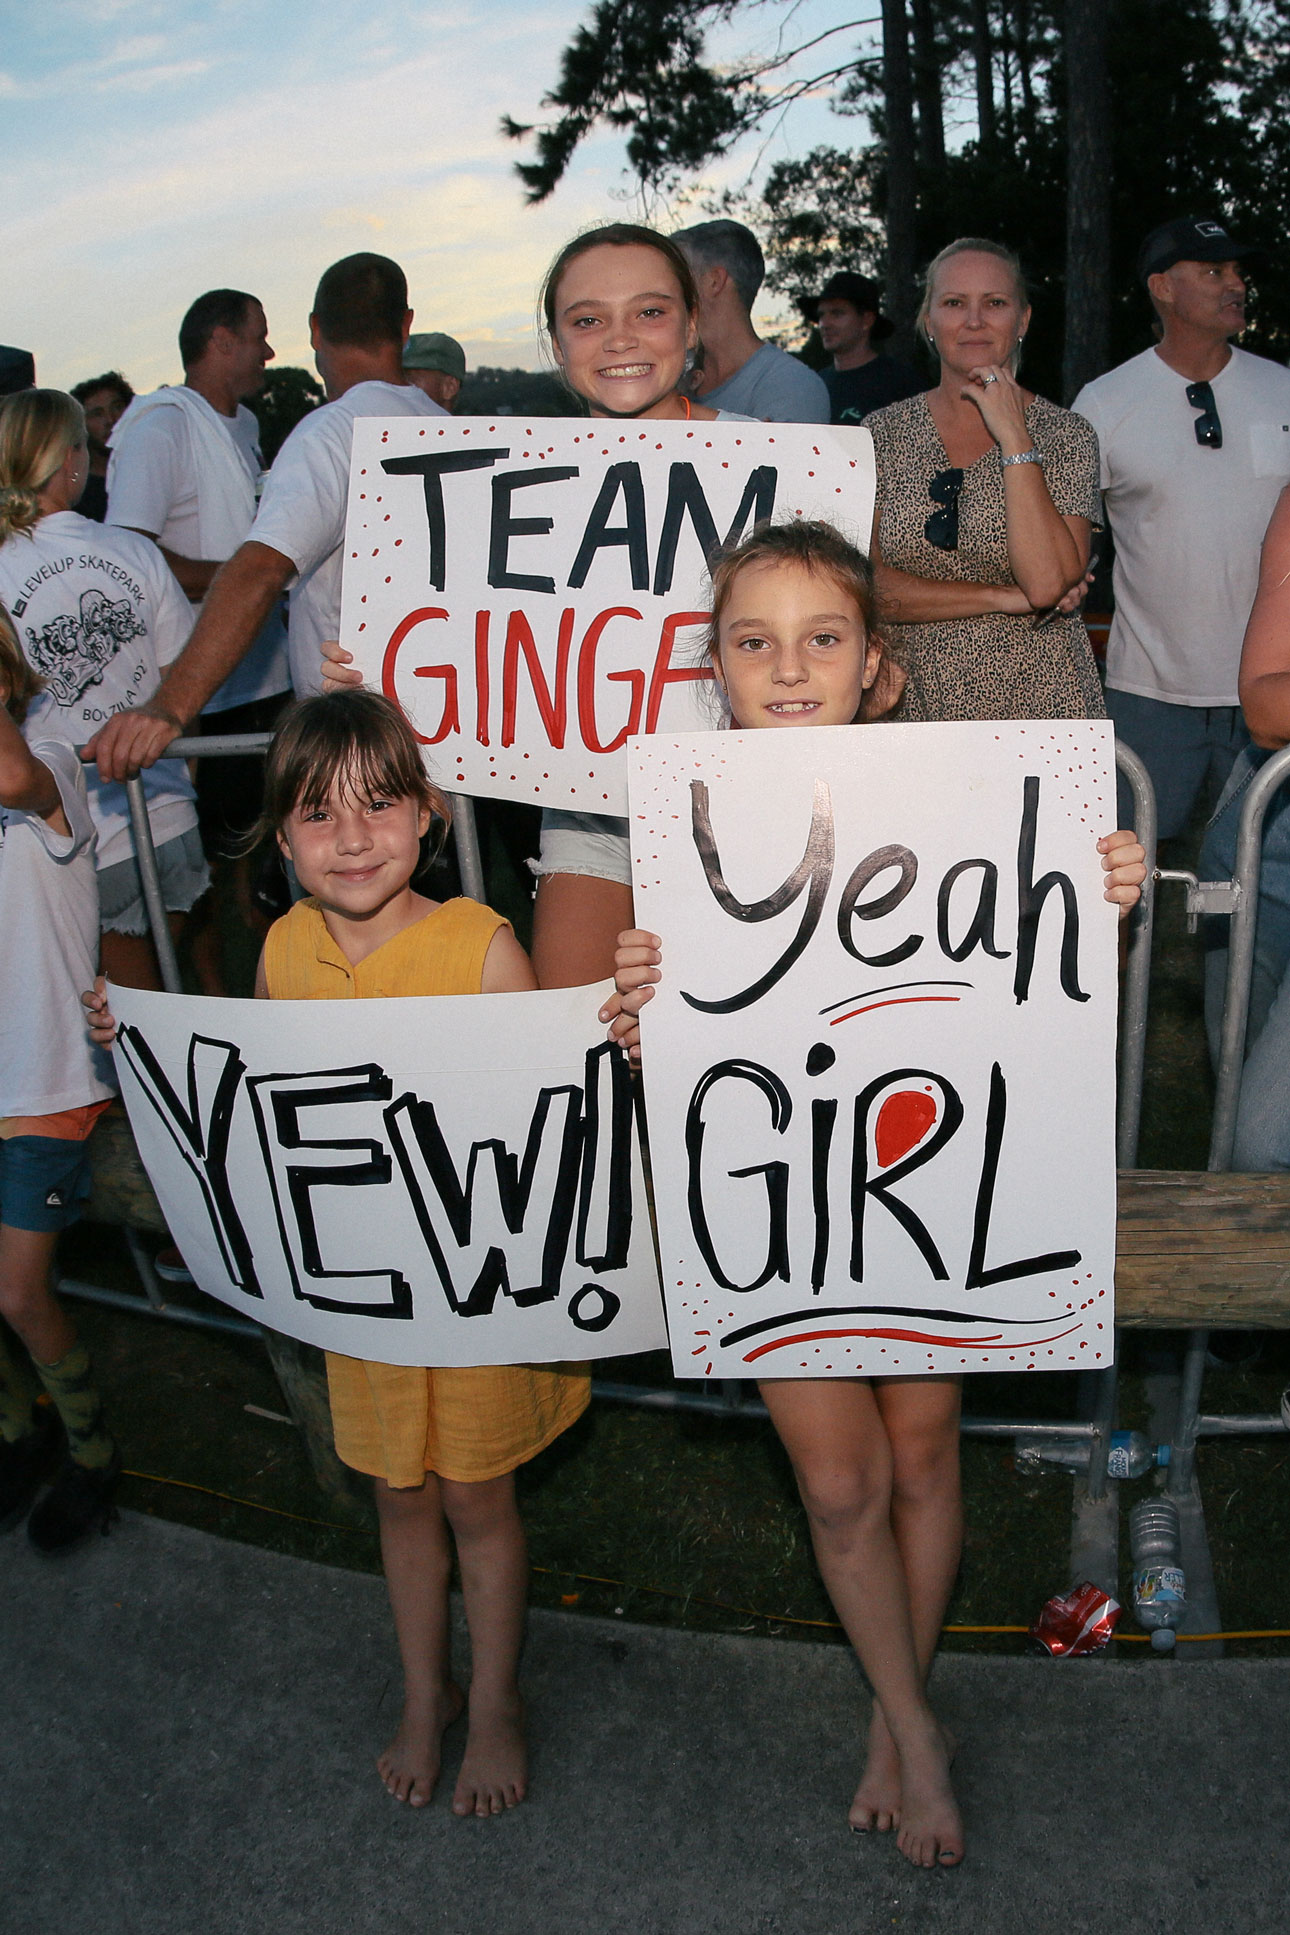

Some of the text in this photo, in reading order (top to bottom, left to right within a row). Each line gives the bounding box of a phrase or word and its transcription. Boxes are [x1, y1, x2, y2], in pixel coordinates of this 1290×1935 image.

[20, 555, 146, 605] LEVELUP SKATEPARK
[380, 448, 777, 595] TEAM
[680, 776, 1091, 1014] Yeah
[116, 1022, 634, 1331] YEW!
